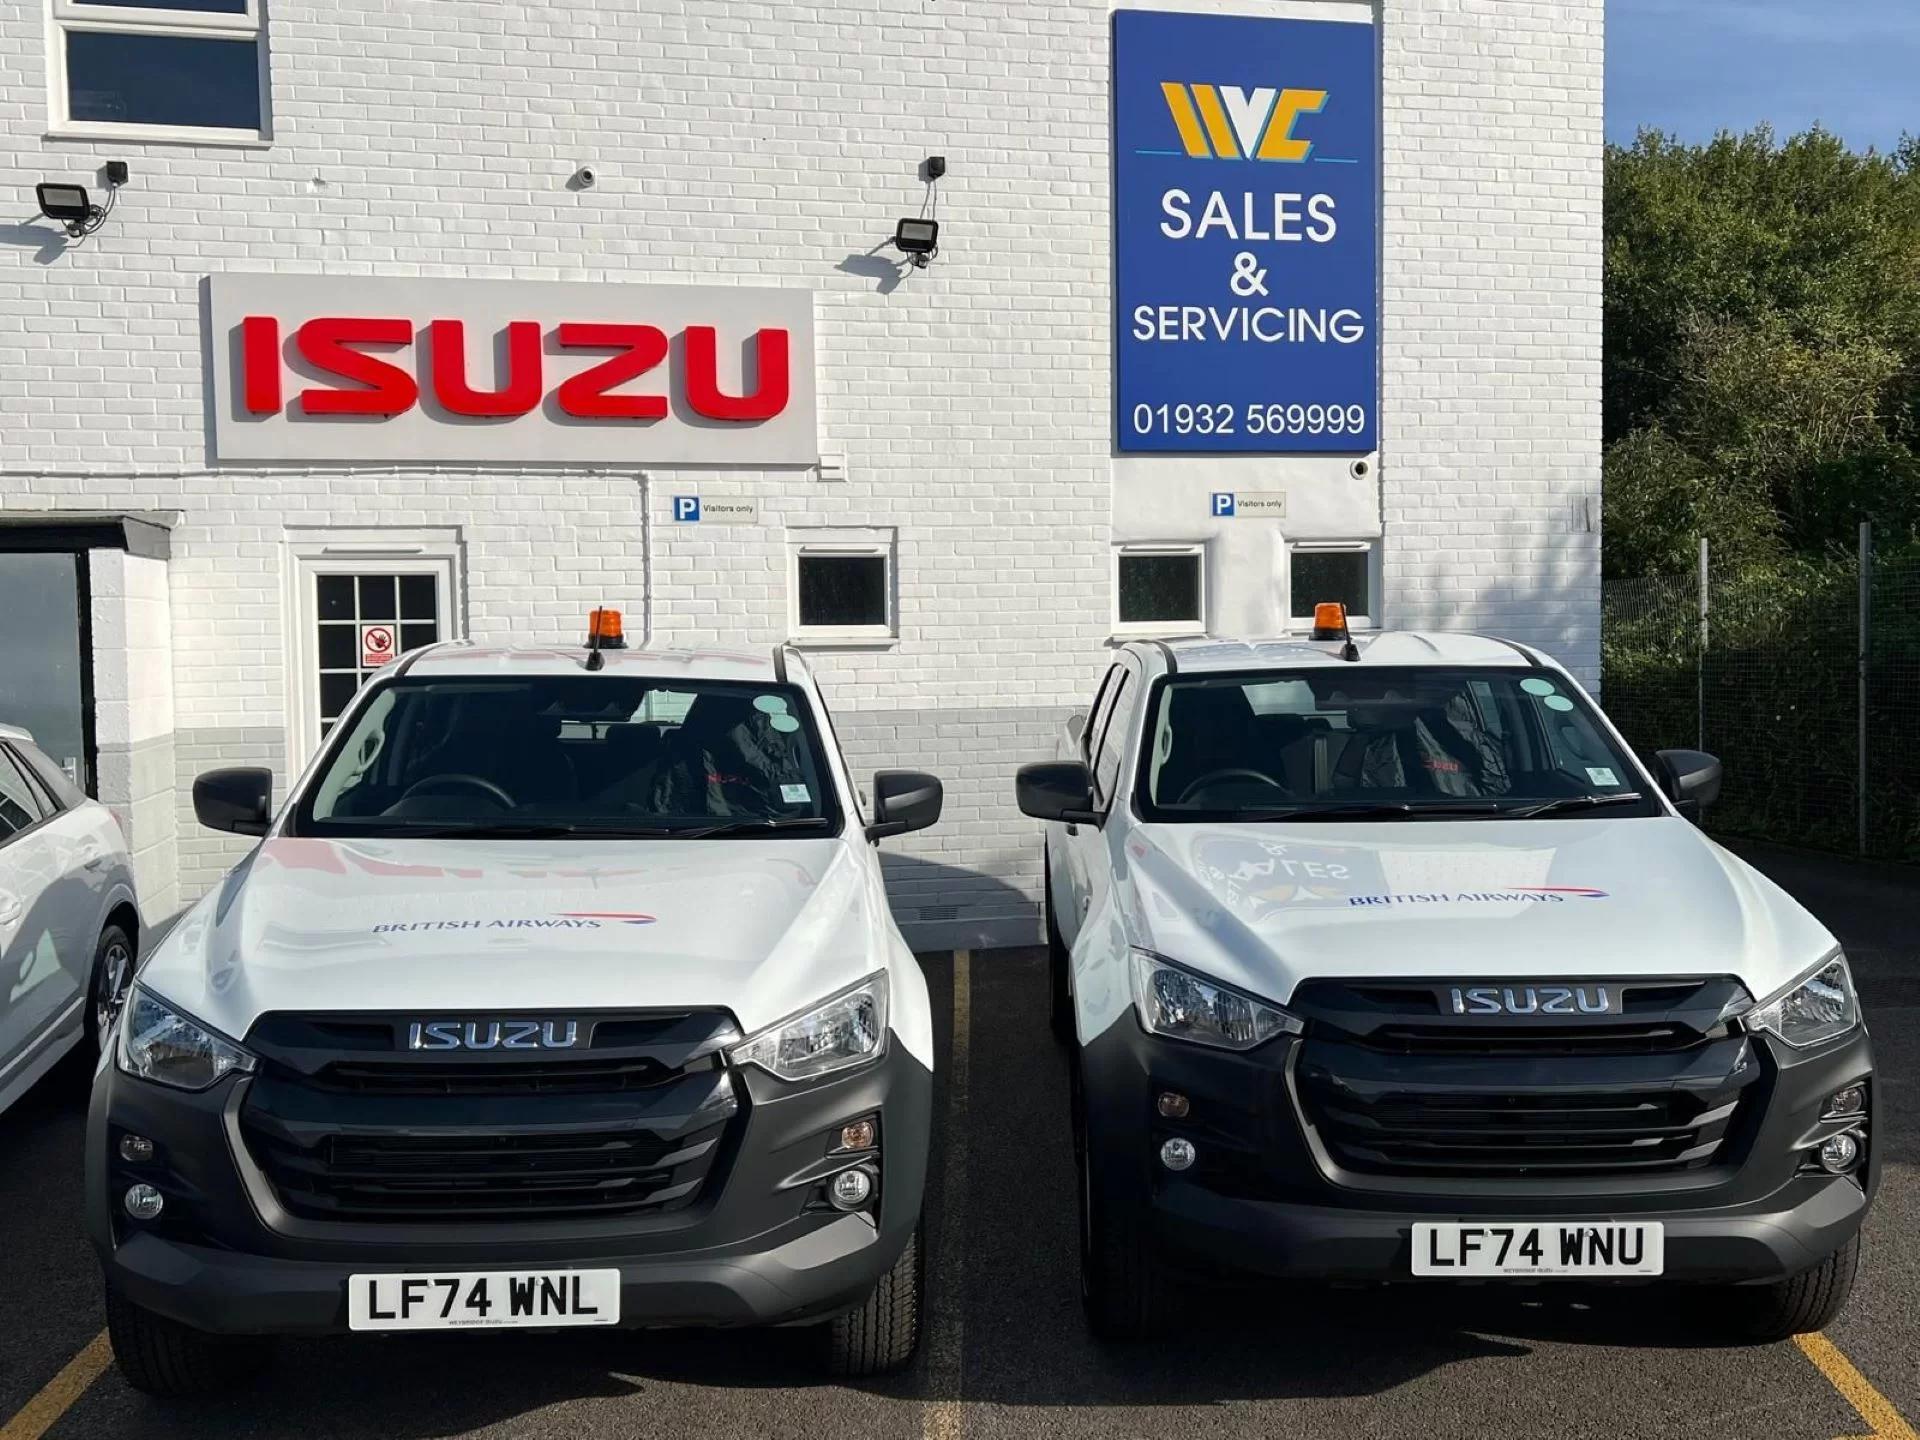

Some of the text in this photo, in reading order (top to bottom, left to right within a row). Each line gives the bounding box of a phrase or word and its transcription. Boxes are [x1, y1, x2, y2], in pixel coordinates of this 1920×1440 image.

[1160, 188, 1337, 243] SALES
[1230, 251, 1269, 297] &
[1133, 305, 1365, 344] SERVICING
[243, 315, 789, 421] ISUZU
[1133, 403, 1365, 435] 01932 569999
[703, 504, 753, 514] Visitors only
[1348, 890, 1564, 906] BRITISH AIRWAYS
[372, 917, 603, 934] BRITISH AIRWAYS
[1450, 988, 1609, 1014] ISUZU
[408, 1021, 577, 1050] ISUZU
[1429, 1228, 1644, 1267] LF74 WNU
[368, 1275, 598, 1319] LF74 WNL
